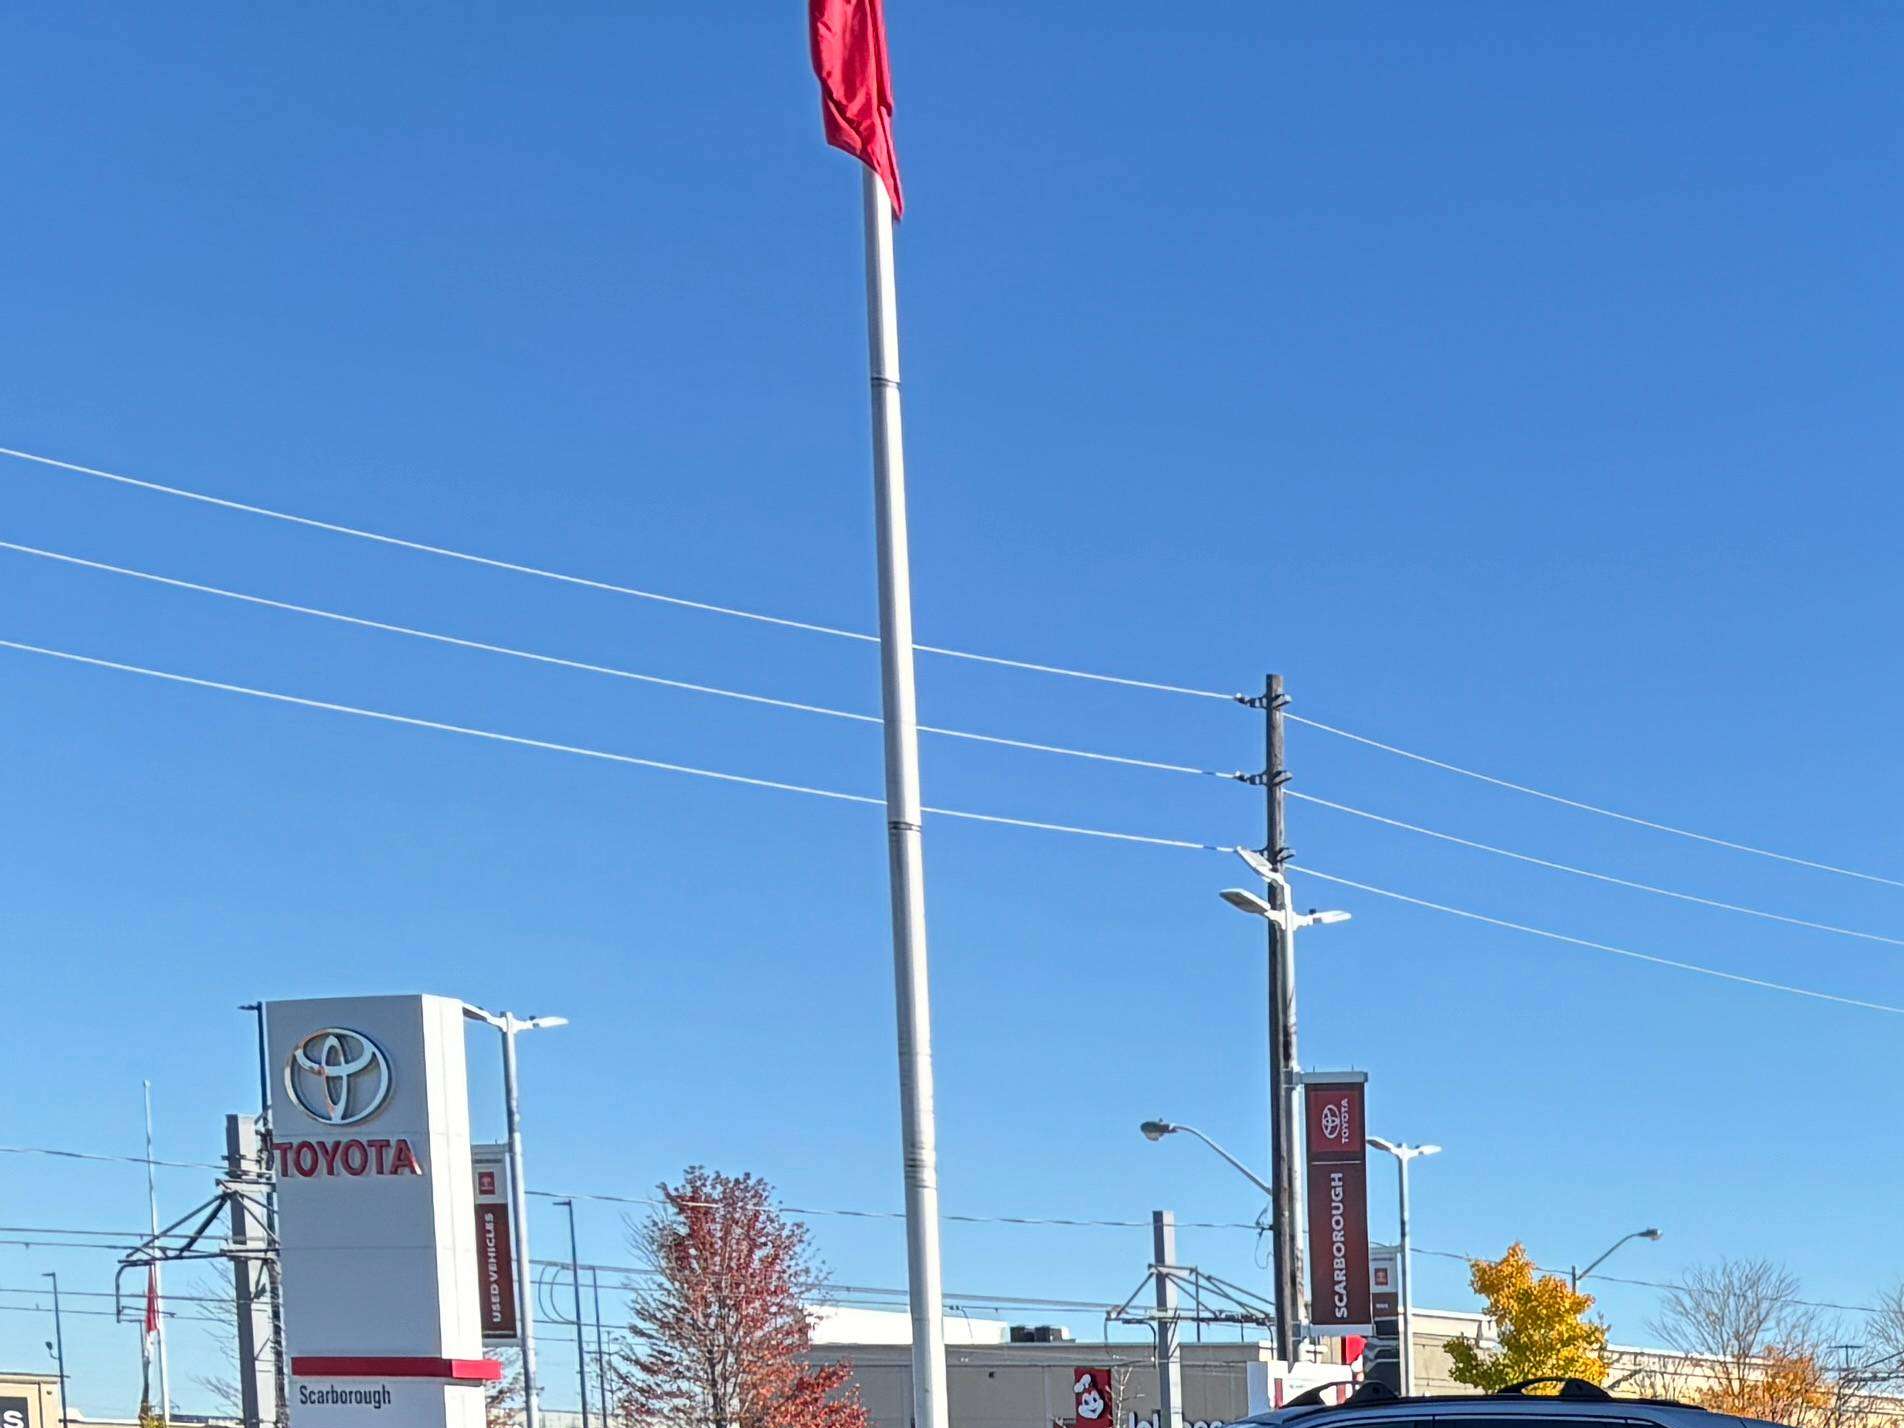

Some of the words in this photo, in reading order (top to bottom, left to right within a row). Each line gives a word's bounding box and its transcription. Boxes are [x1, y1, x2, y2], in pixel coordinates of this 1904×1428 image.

[1341, 1098, 1349, 1144] TOYOTA
[271, 1138, 423, 1178] TOYOTA
[484, 1212, 500, 1283] VEHICLES
[1330, 1172, 1348, 1319] SCARBOROUGH
[491, 1286, 502, 1323] USED
[299, 1384, 391, 1409] Scarborough
